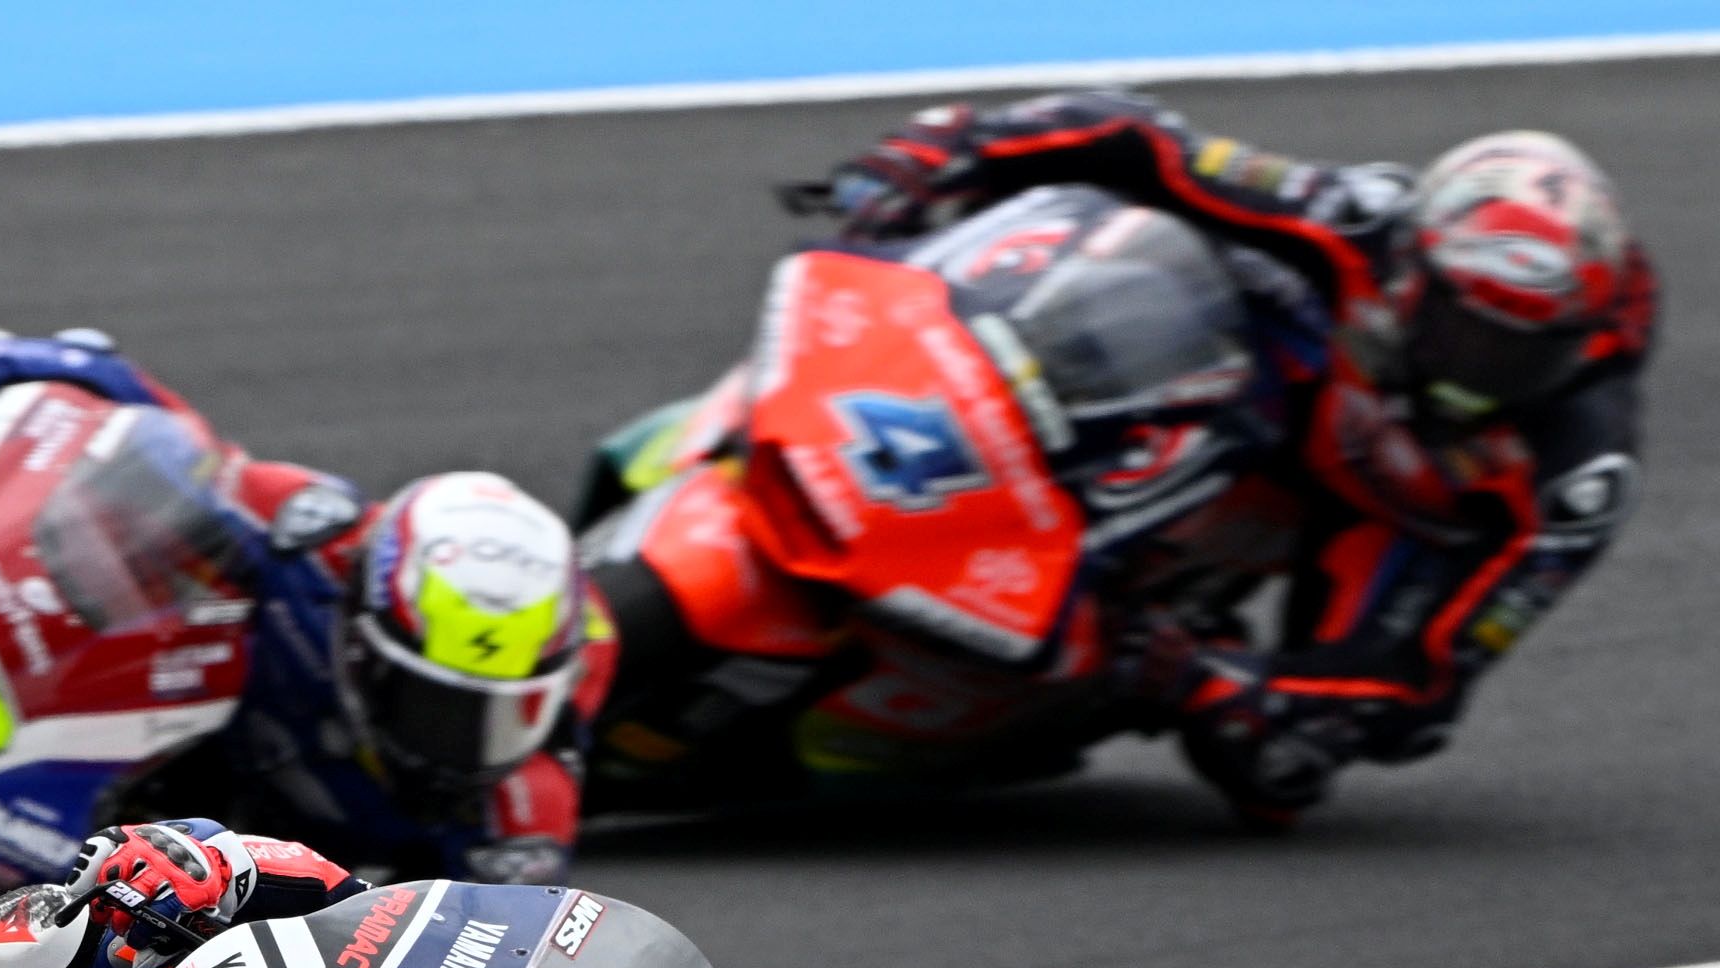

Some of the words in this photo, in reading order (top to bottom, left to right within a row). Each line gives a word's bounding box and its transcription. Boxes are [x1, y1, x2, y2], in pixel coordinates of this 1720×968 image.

[827, 391, 988, 513] 4
[106, 881, 147, 908] 28
[555, 894, 604, 956] WRS
